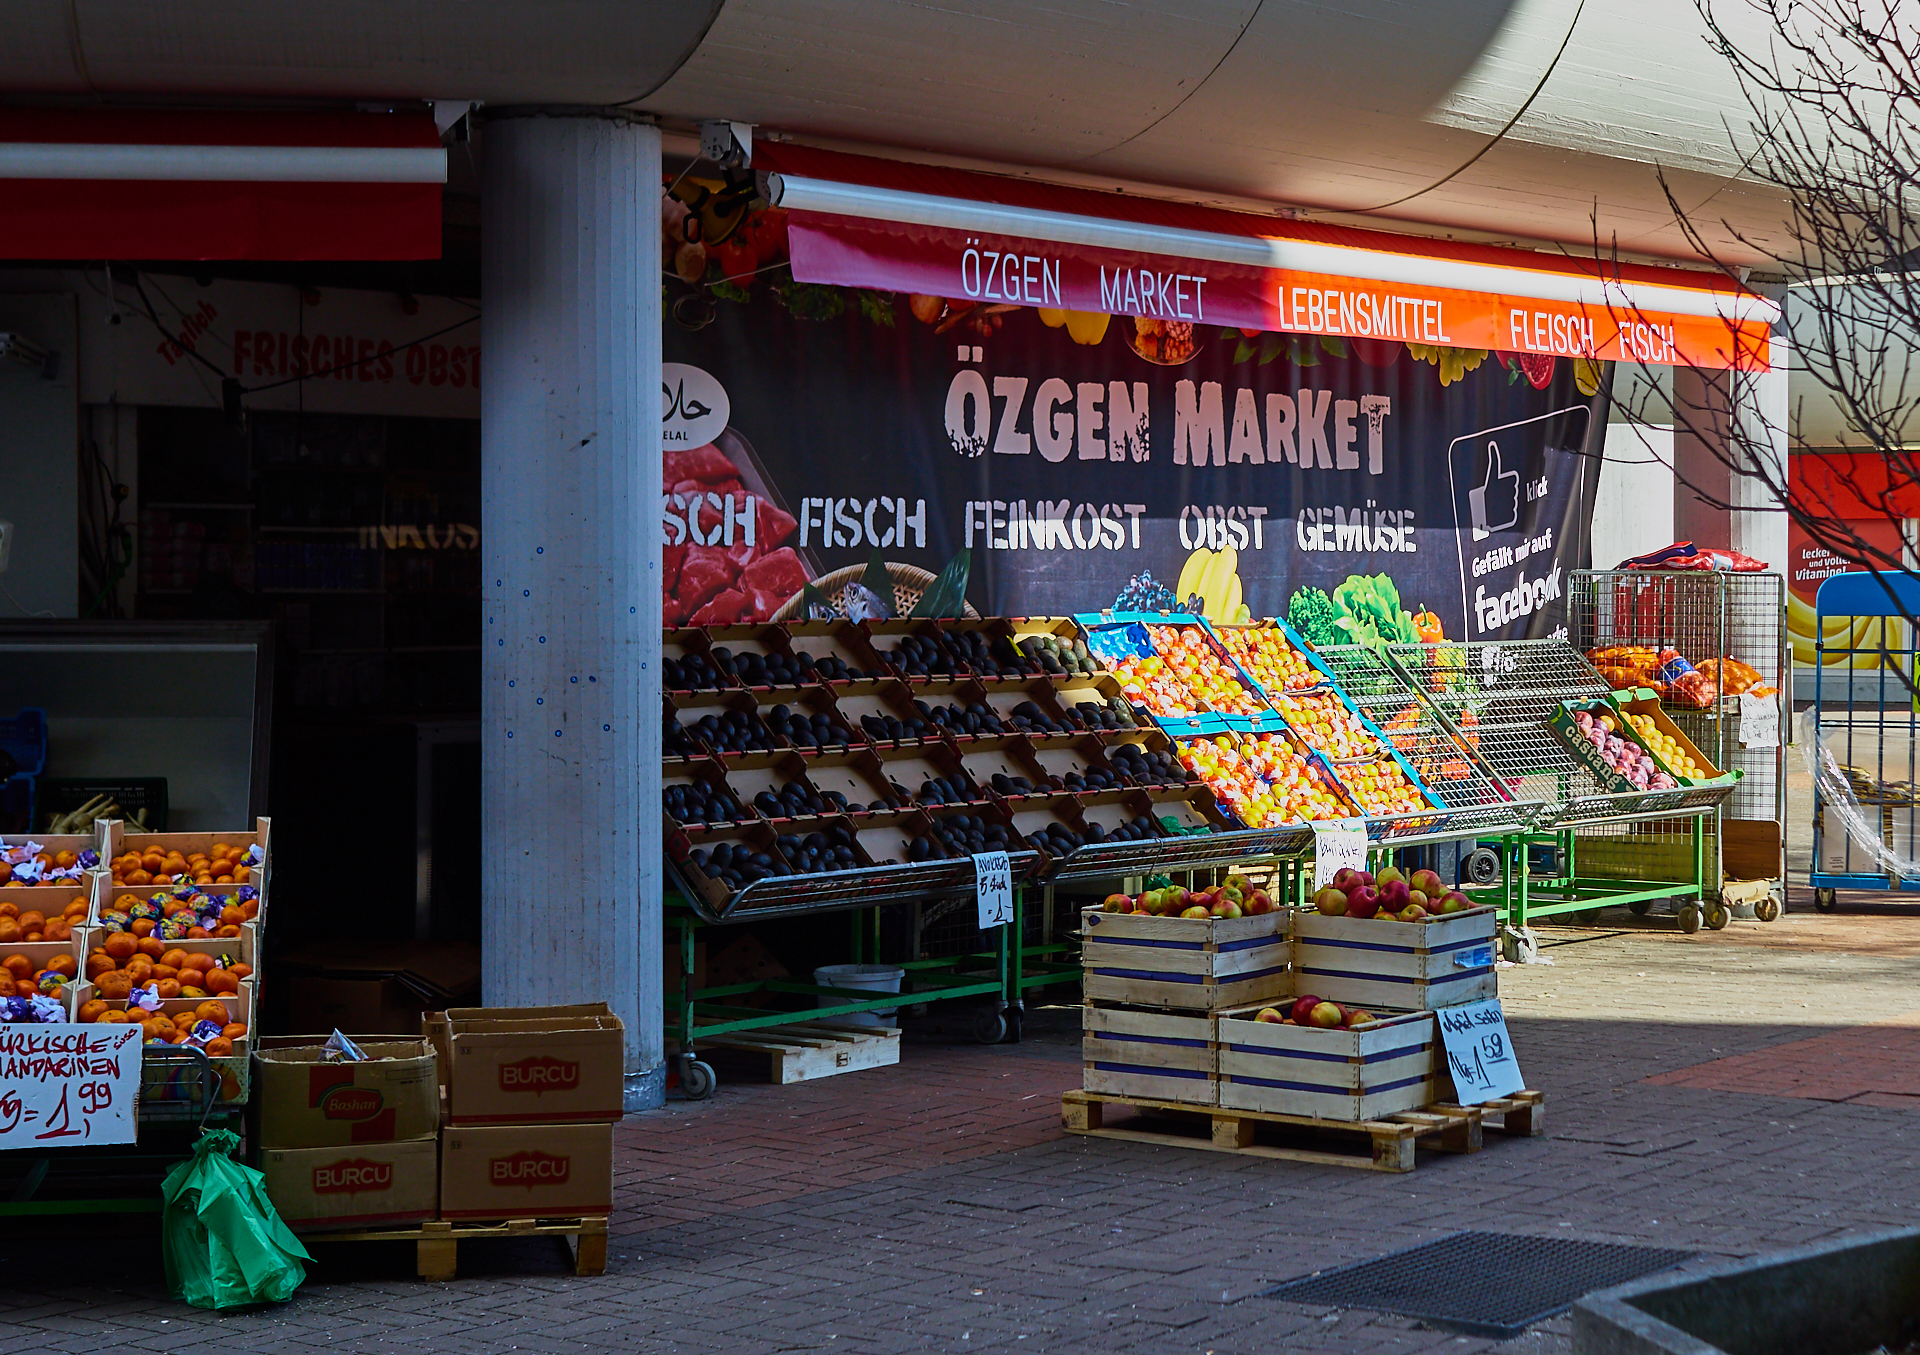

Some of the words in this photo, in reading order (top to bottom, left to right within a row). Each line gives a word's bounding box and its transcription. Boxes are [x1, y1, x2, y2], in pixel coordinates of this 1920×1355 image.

[961, 237, 1061, 305] ÖZGEN
[1100, 265, 1207, 320] MARKET
[1278, 286, 1450, 342] LEBENSMITTEL
[1510, 309, 1595, 357] FLEISCH
[1618, 321, 1677, 362] FISCH
[157, 299, 218, 366] Täglich
[234, 330, 394, 383] FRISCHES
[405, 343, 481, 389] OBST
[944, 345, 1150, 462] ÖZGEN
[1173, 379, 1391, 475] MARKET
[1526, 476, 1548, 502] klick
[800, 496, 926, 548] FISCH
[965, 498, 1146, 550] FEINKOST
[1179, 504, 1268, 550] OBST
[1297, 499, 1417, 552] GEMÜSE
[1472, 545, 1513, 578] Gefällt
[1515, 538, 1530, 560] mir
[1532, 528, 1552, 553] auf
[1809, 559, 1823, 568] und
[1824, 556, 1851, 566] volle
[1475, 557, 1562, 633] facebook
[1565, 726, 1623, 790] castang
[0, 1053, 120, 1082] ANDARINEN
[503, 1065, 576, 1085] BURCU
[315, 1165, 391, 1188] BURCU
[493, 1159, 568, 1179] BURCU
